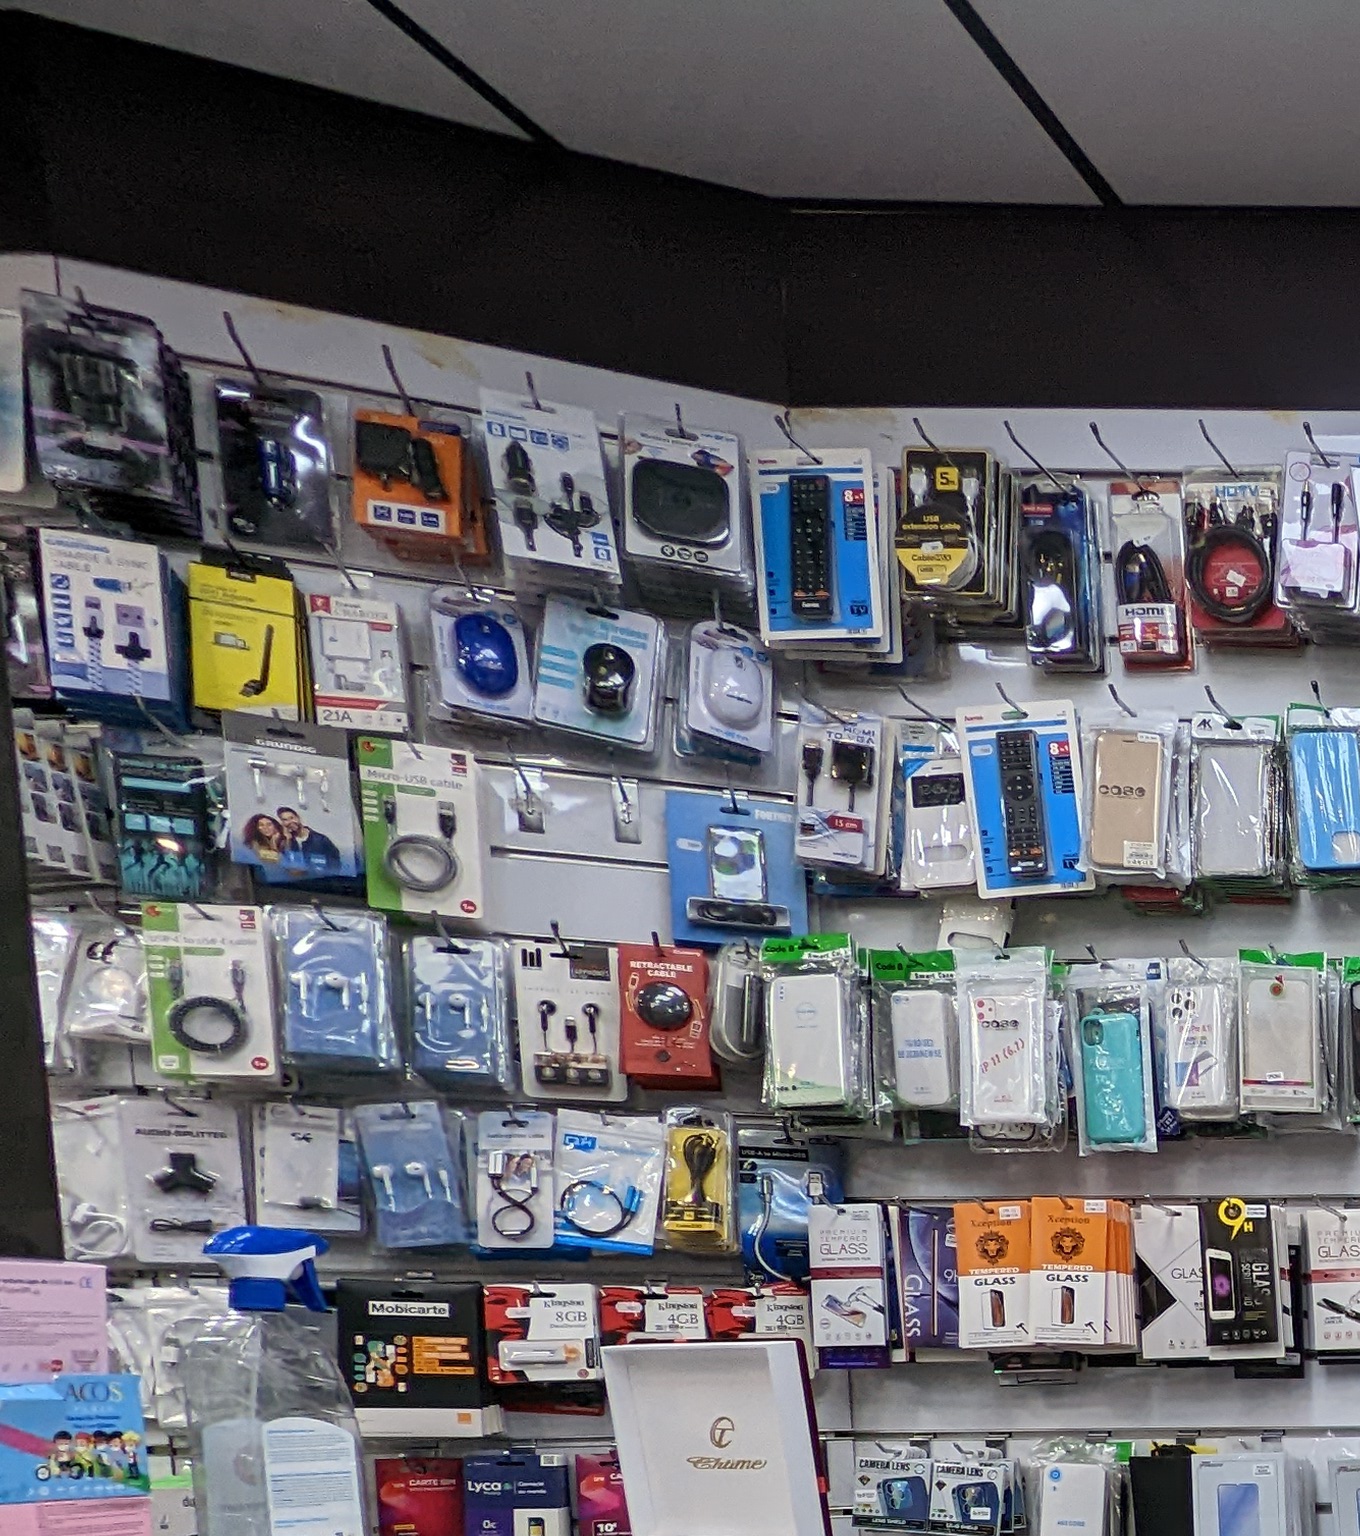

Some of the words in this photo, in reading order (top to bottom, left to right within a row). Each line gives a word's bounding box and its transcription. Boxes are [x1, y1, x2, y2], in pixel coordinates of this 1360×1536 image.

[1214, 484, 1260, 498] HDTV
[257, 738, 317, 753] GRUNDIG
[367, 769, 428, 786] Micro-USB
[431, 776, 464, 791] cable
[629, 960, 694, 973] RETRACTABLE
[647, 969, 677, 979] CABLE
[970, 1217, 1012, 1228] Xception
[1047, 1214, 1091, 1225] Xception
[819, 1242, 869, 1255] GLASS
[968, 1266, 1020, 1276] TEMPERED
[1041, 1264, 1093, 1274] TEMPERED
[1045, 1273, 1090, 1285] GLASS
[370, 1302, 447, 1316] Mobicarte
[542, 1299, 586, 1310] Kingston
[657, 1301, 698, 1312] Kingston
[766, 1301, 804, 1312] Kingston
[555, 1310, 588, 1323] 8GB
[667, 1313, 699, 1325] 4GB
[775, 1314, 805, 1326] 4GB
[63, 1380, 126, 1403] ACOS
[858, 1459, 891, 1471] CAMERA
[891, 1462, 911, 1473] LENS
[935, 1464, 964, 1477] CAMERA
[964, 1467, 984, 1479] LENS
[467, 1480, 502, 1495] Lyca
